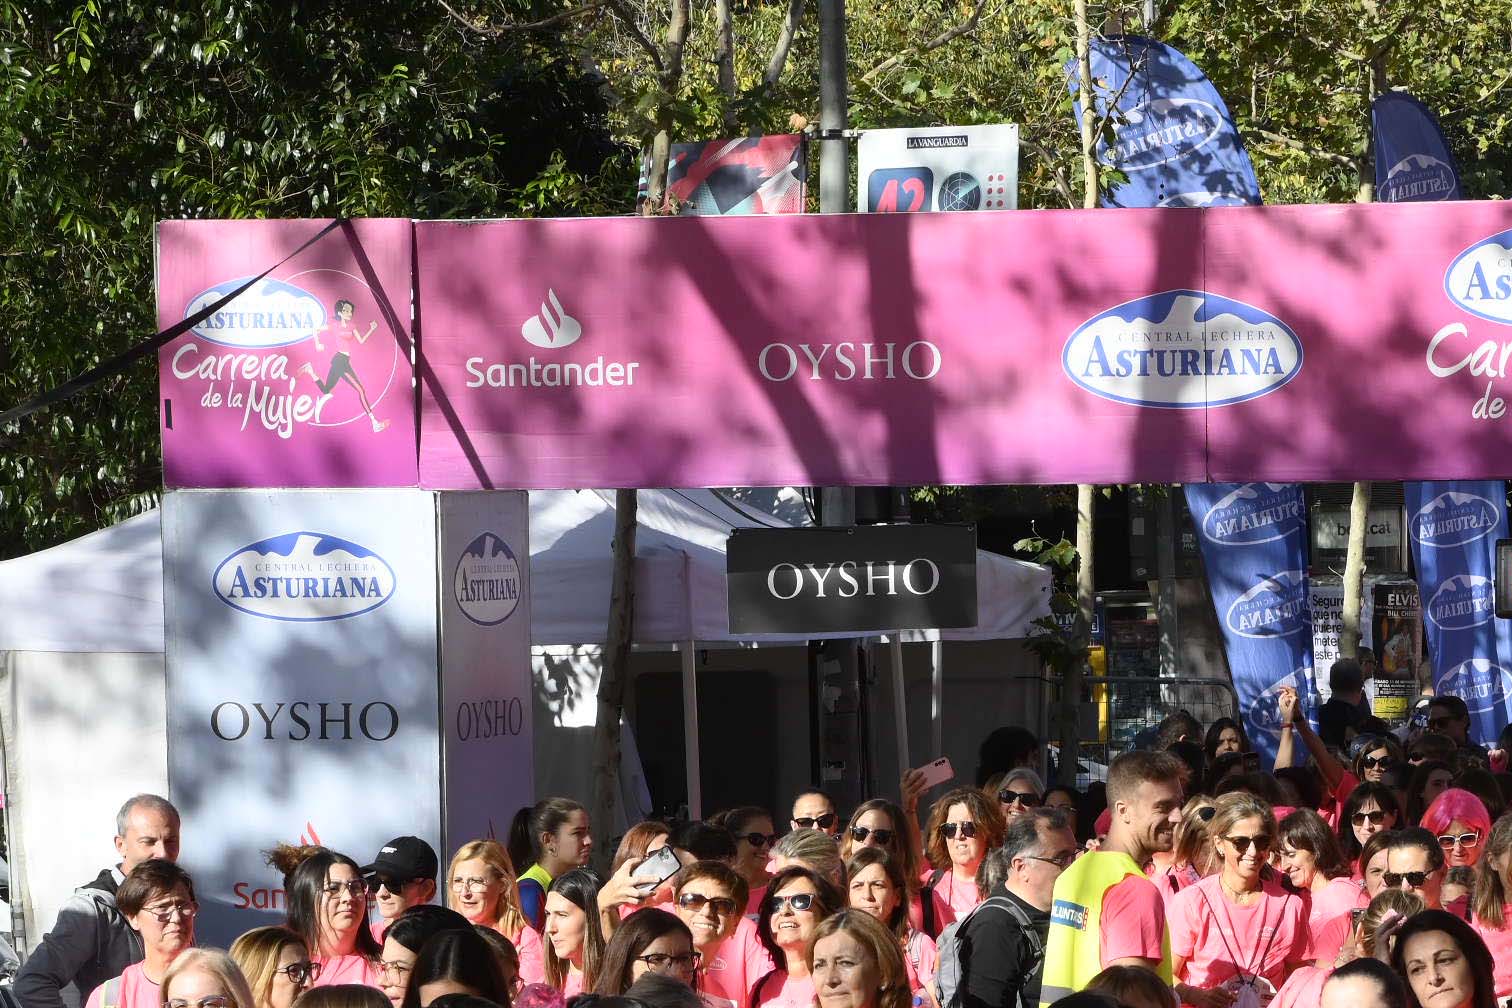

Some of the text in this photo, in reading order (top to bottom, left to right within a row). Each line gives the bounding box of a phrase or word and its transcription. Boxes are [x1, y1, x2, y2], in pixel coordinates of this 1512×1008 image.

[1082, 334, 1283, 378] ASTURIANA
[1117, 330, 1277, 343] CENTRAL LECHERA
[172, 343, 289, 381] Carrera
[466, 357, 640, 388] Santander
[758, 340, 942, 382] OYSHO
[201, 376, 333, 439] de la Mujer
[1472, 381, 1507, 420] de
[227, 565, 384, 599] ASTURIANA
[460, 567, 518, 602] ASTURIANA
[767, 557, 940, 600] OYSHO
[1387, 593, 1418, 606] ELVIS
[210, 701, 399, 742] OYSHO
[456, 697, 523, 742] OYSHO
